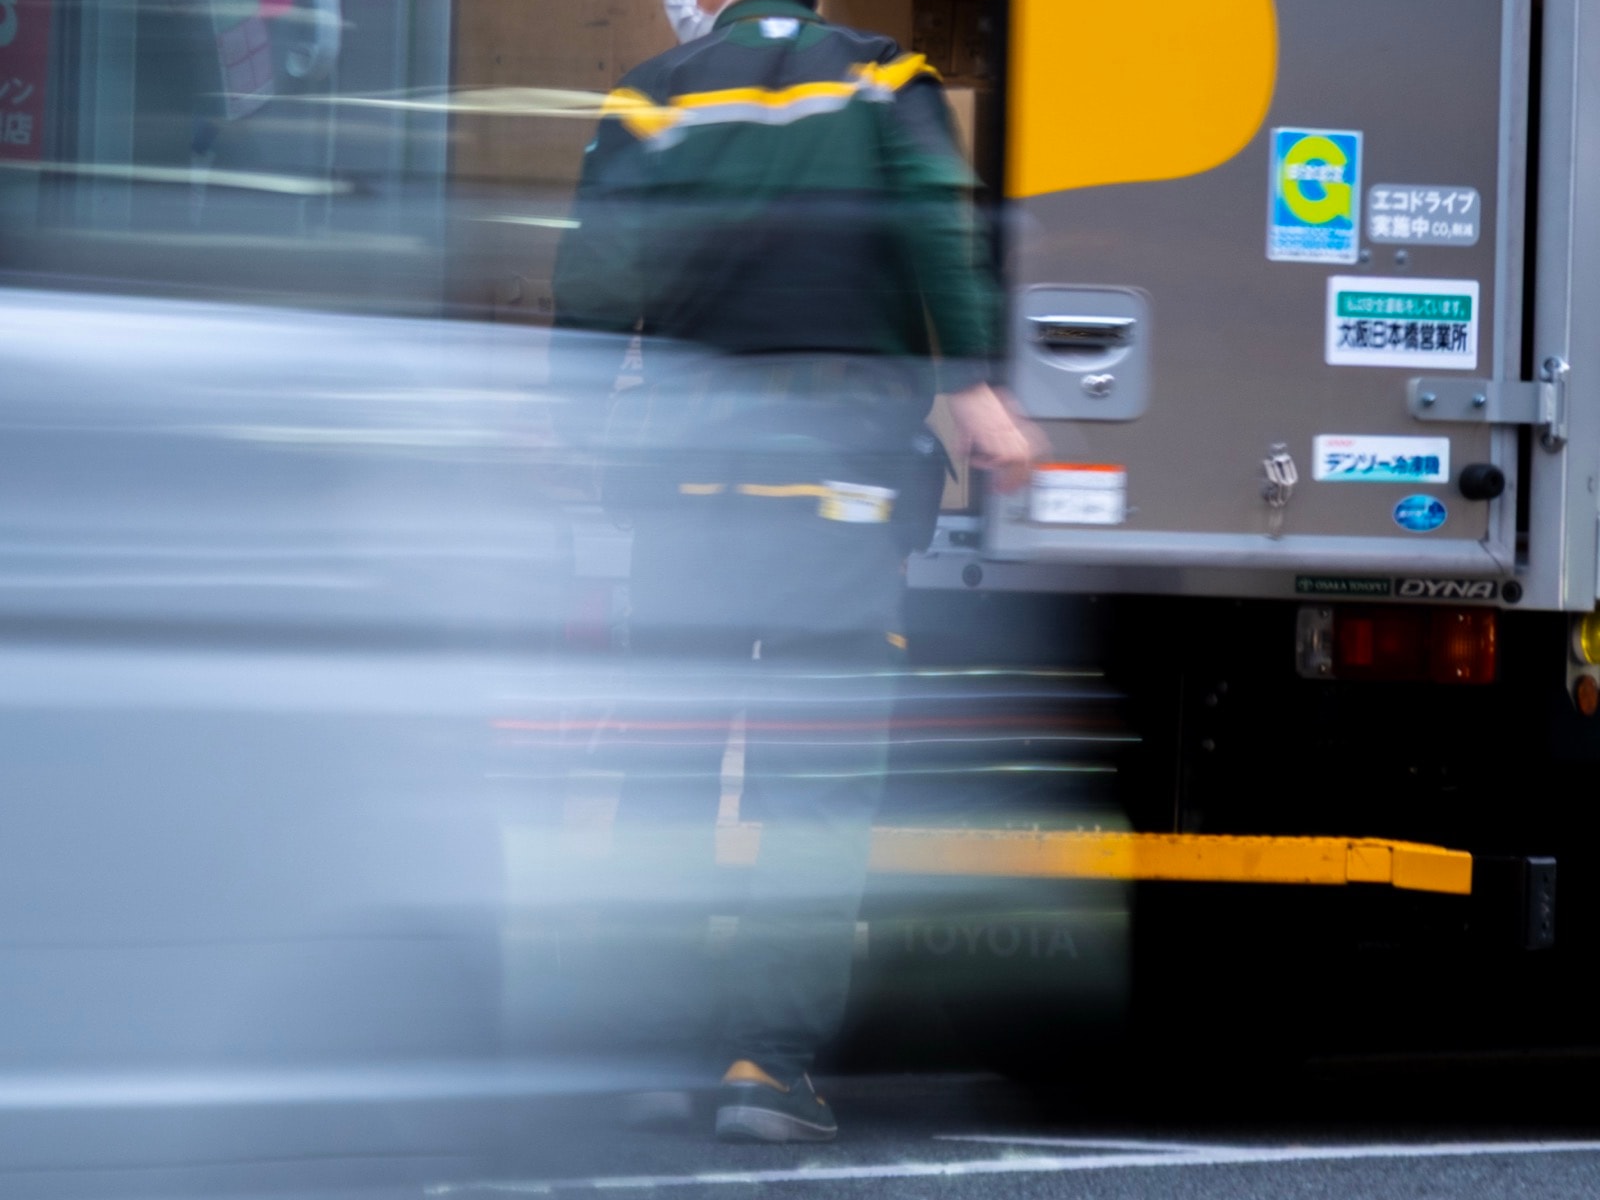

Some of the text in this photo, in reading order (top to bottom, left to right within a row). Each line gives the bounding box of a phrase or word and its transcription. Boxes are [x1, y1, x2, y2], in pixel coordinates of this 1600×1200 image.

[1372, 190, 1476, 214] エコドライブ
[1371, 215, 1430, 238] 実施中
[1337, 320, 1467, 352] 大阪日本橋営業所
[1400, 579, 1494, 598] DYNA
[898, 920, 1079, 959] TOYOTA
